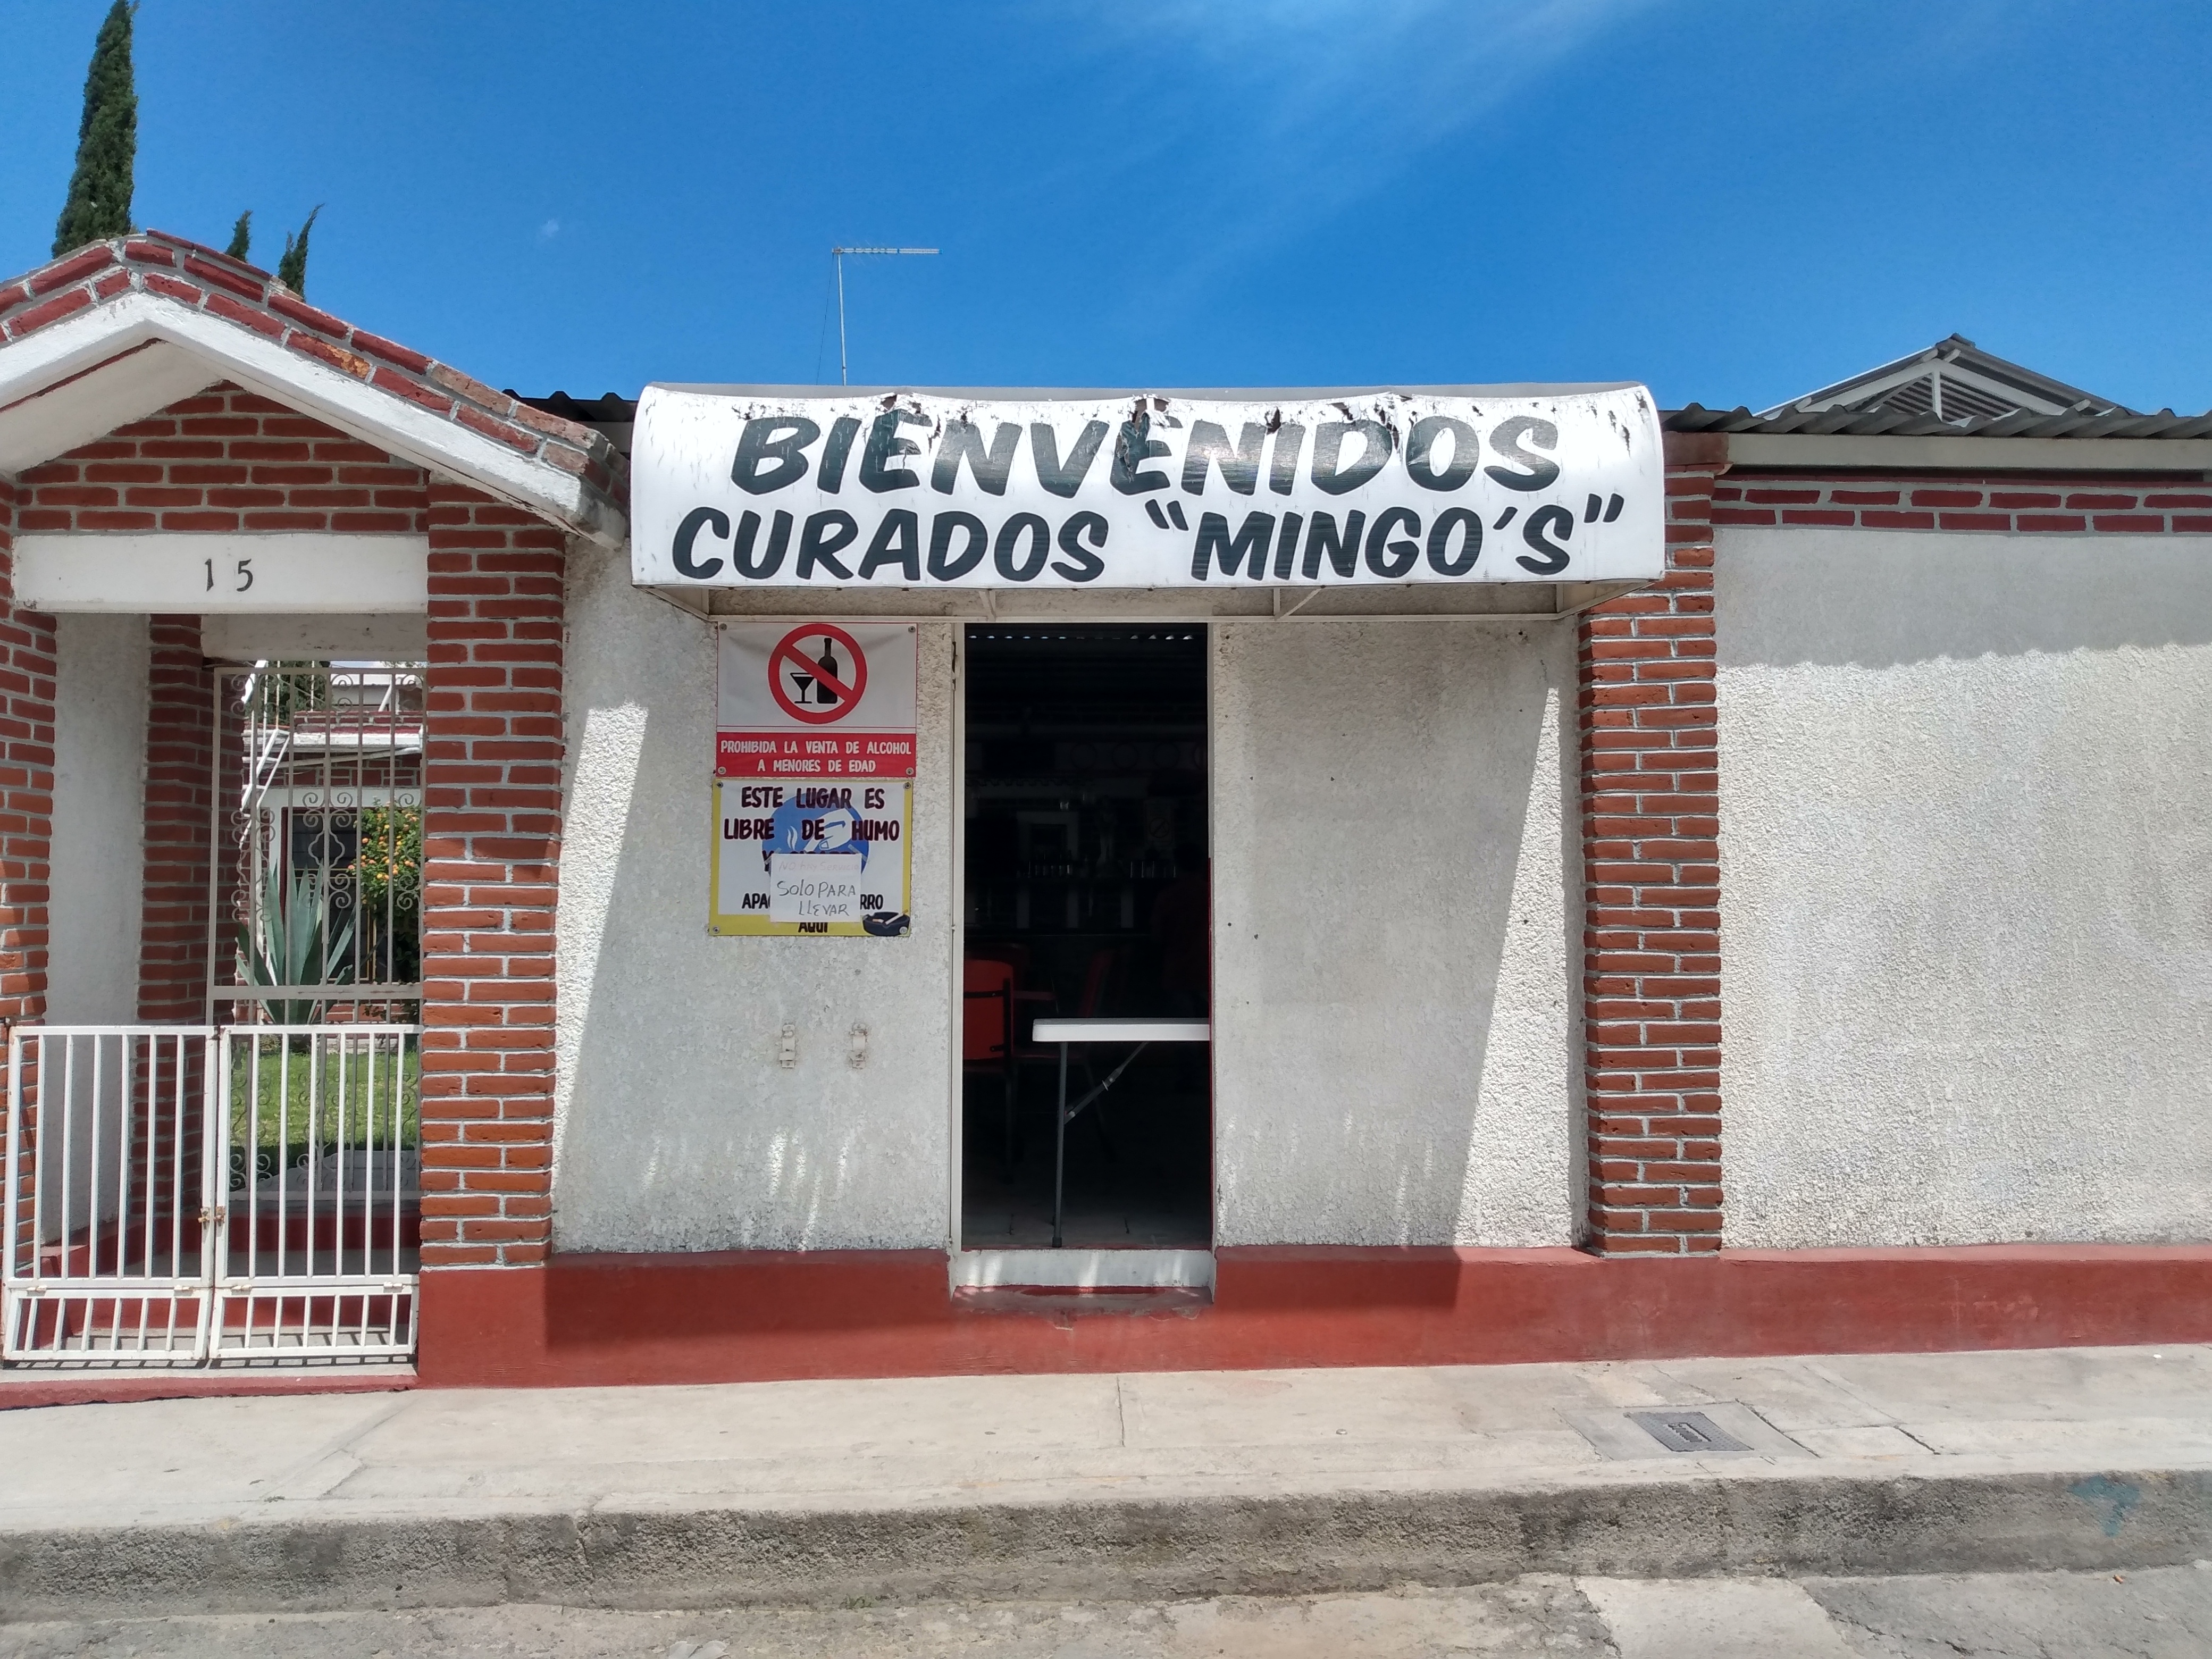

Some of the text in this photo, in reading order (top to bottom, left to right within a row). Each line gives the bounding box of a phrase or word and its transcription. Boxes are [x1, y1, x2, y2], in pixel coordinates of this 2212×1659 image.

[731, 413, 1559, 498] BIENVENIDOS
[673, 507, 1109, 581] CURADOS
[720, 740, 912, 755] PROHIBIDA LA VENTA DE ALCOHOL
[757, 759, 876, 772] A MENORES DE EDAD
[741, 786, 885, 809] ESTE LUGAR ES
[724, 818, 900, 841] LIBRE DE HUMO
[818, 881, 856, 899] PARA
[742, 893, 770, 909] APA
